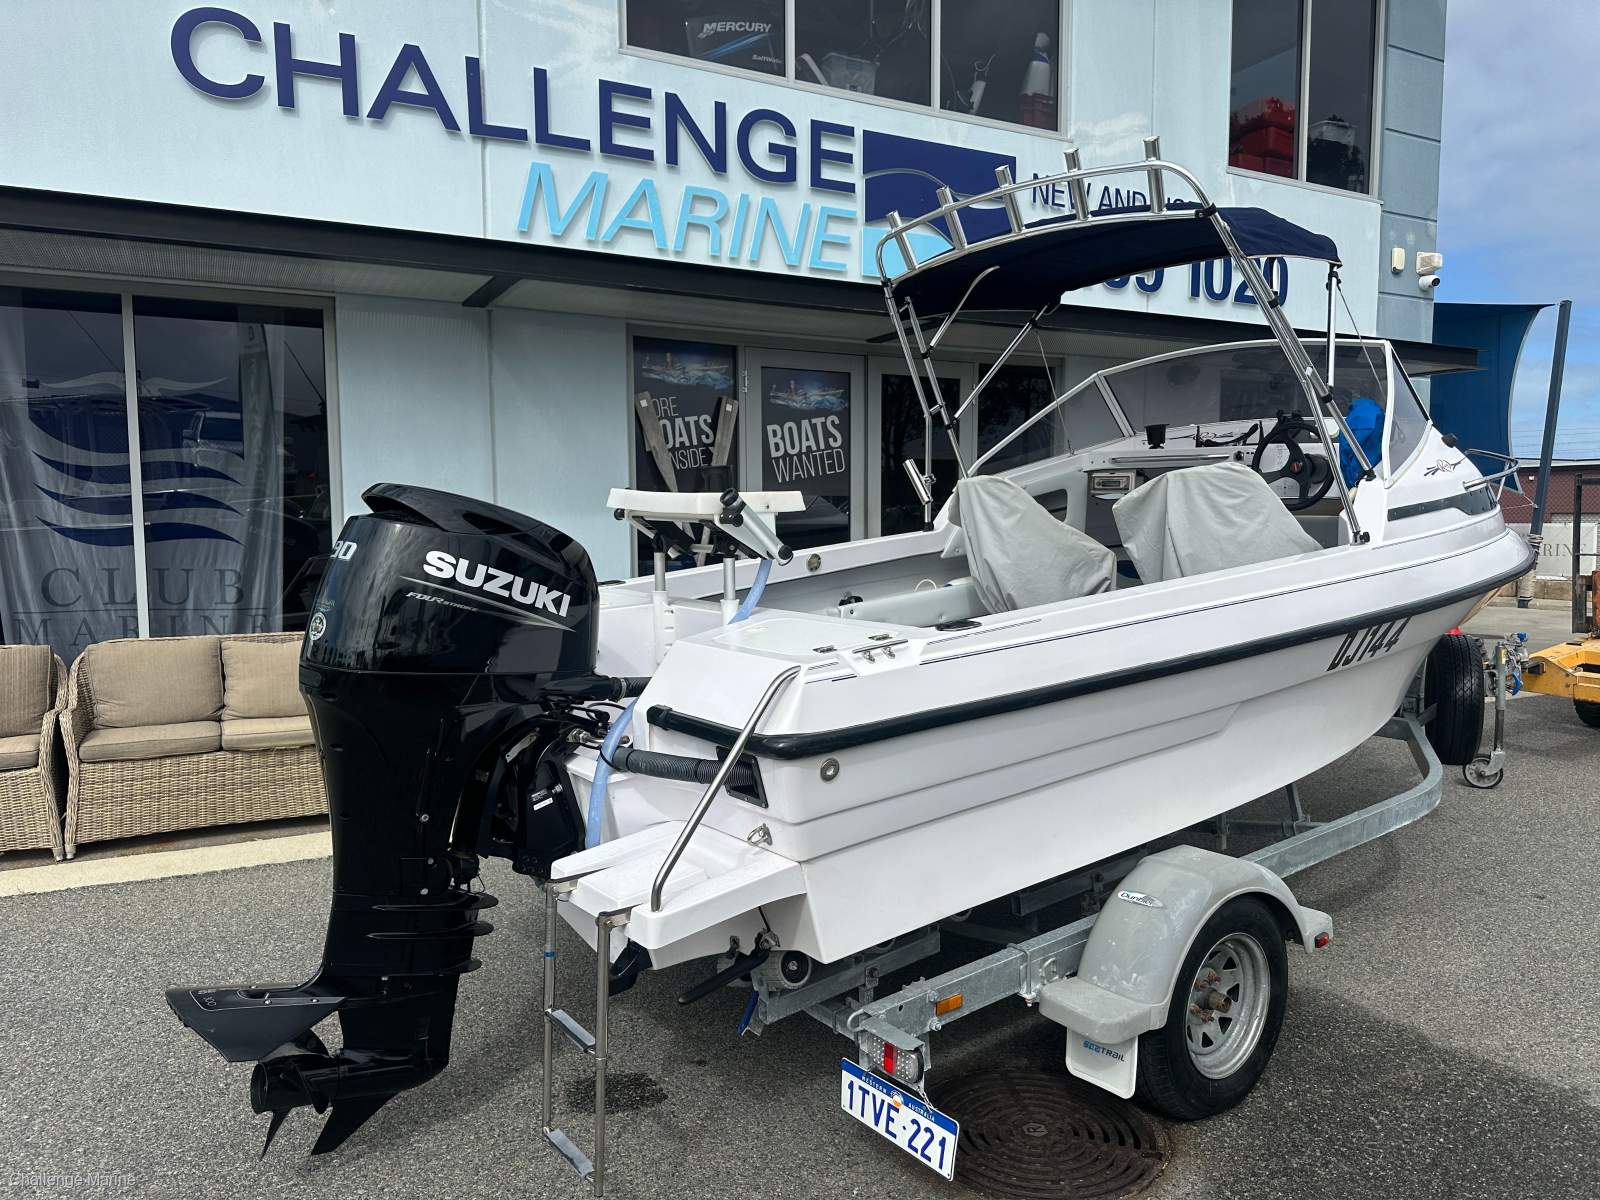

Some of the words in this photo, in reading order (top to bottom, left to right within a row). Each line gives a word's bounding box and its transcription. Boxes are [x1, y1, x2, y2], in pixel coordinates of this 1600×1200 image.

[702, 21, 772, 34] MERCURY
[171, 6, 856, 194] CHALLENGE
[516, 161, 857, 272] MARINE
[1098, 185, 1147, 210] AND
[652, 396, 679, 418] ORE
[659, 414, 715, 449] OATS
[766, 414, 843, 459] BOATS
[669, 447, 710, 470] NSIDE
[772, 448, 846, 483] WANTED
[40, 566, 245, 608] CLUB
[422, 550, 571, 618] SUZUKI
[861, 1075, 887, 1094] WESTERN
[908, 1103, 935, 1123] AUSTRALIA
